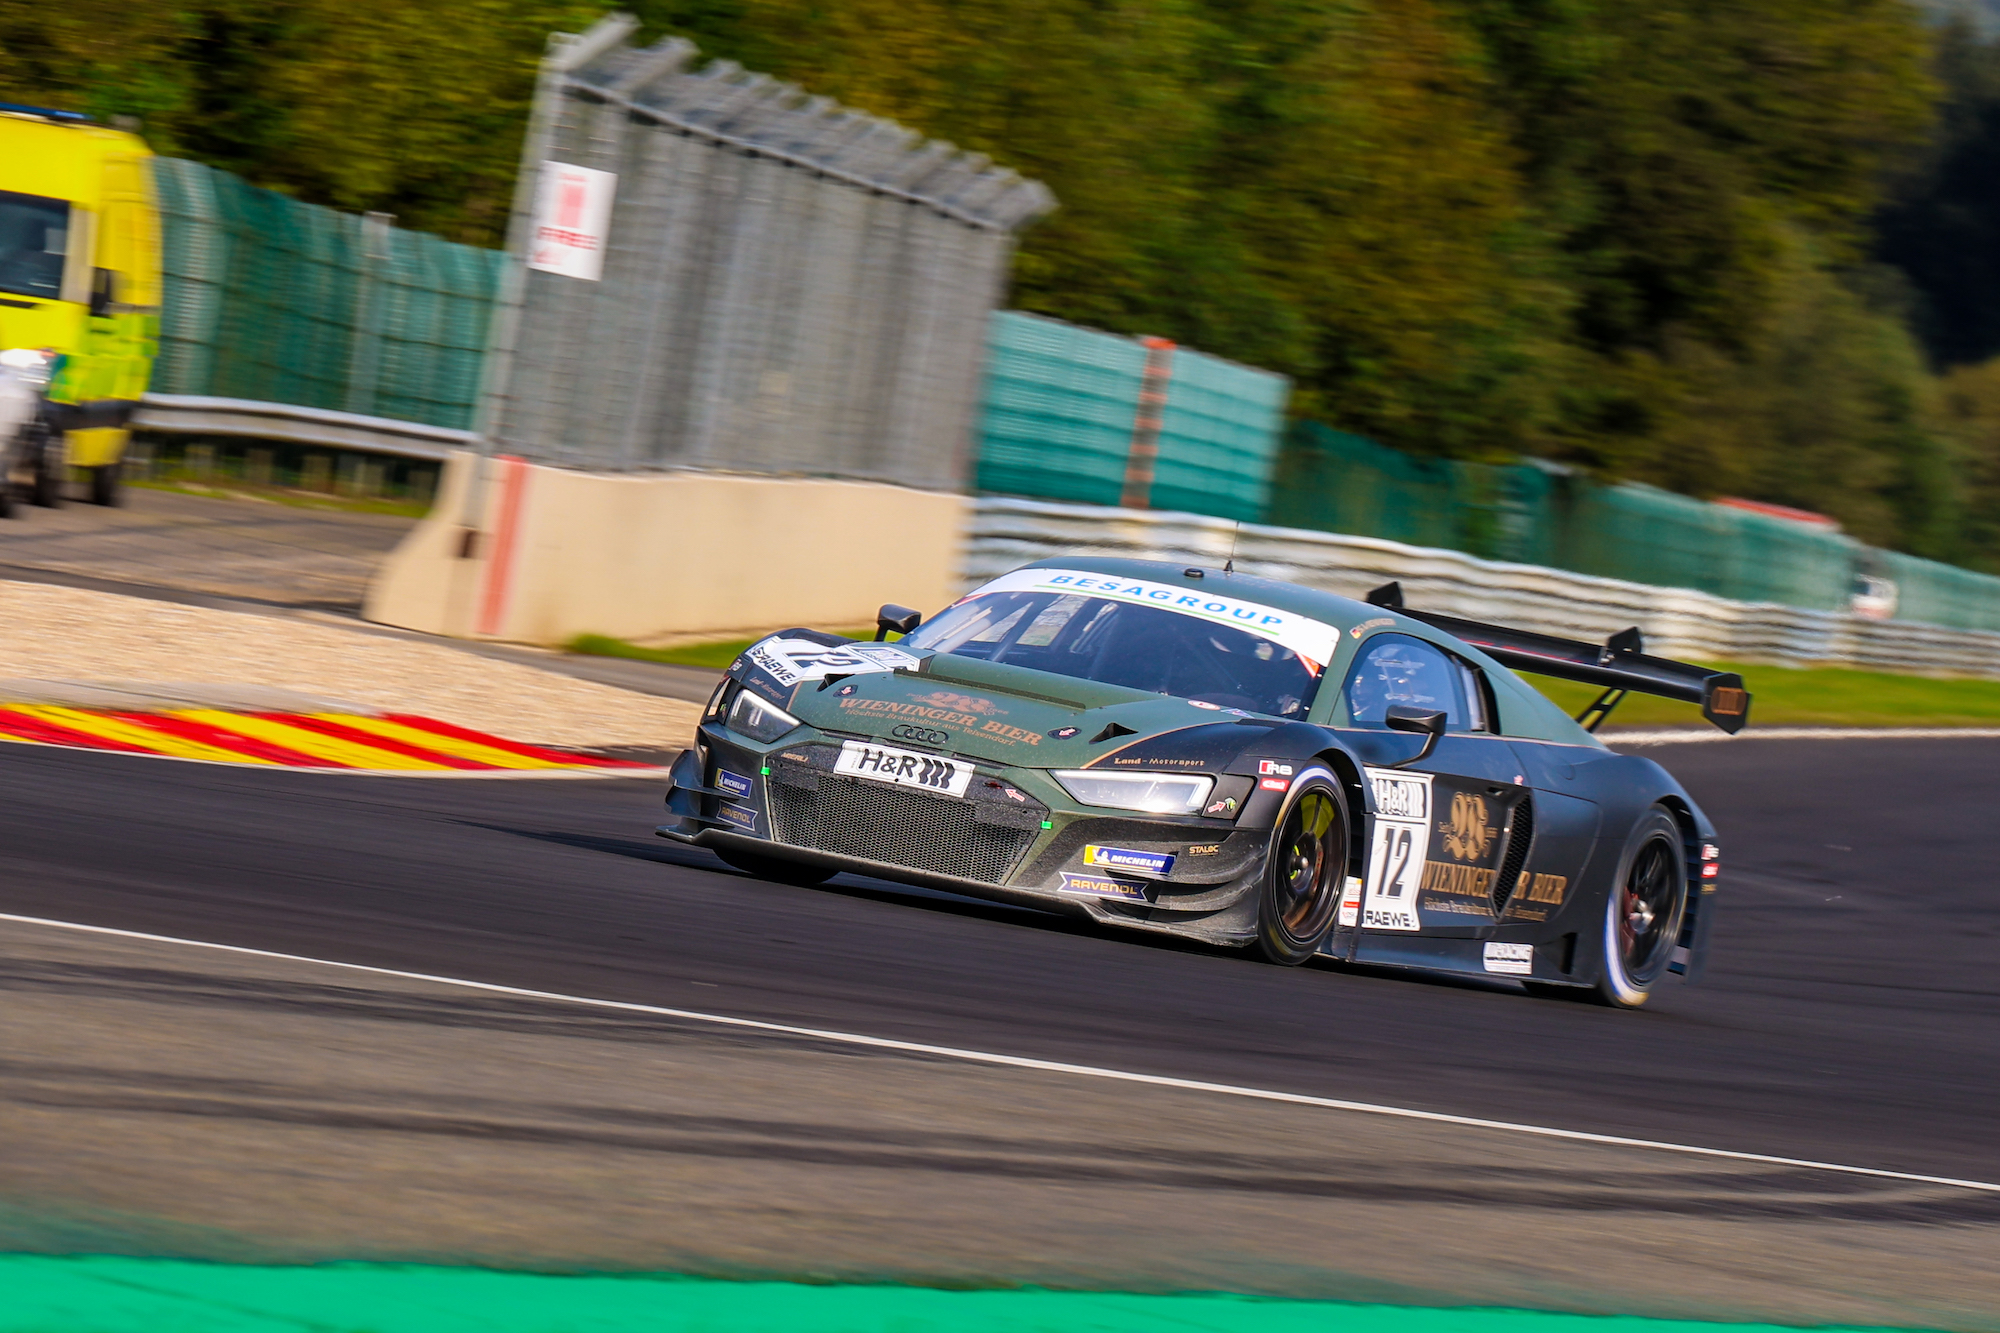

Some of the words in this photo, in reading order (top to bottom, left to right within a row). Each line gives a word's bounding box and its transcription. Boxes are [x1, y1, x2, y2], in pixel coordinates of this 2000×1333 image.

[1049, 575, 1283, 626] BESAGROUP
[838, 698, 979, 727] WIENINGER
[980, 719, 1044, 746] BIER
[858, 748, 918, 778] H&R
[723, 777, 747, 791] MICHELIN
[721, 806, 751, 824] RAVENOL
[1189, 844, 1220, 855] STALOC
[1110, 854, 1166, 868] MICHELIN
[1375, 827, 1413, 898] 12
[1070, 878, 1138, 895] RAVENOL
[1366, 909, 1411, 927] RAEWE
